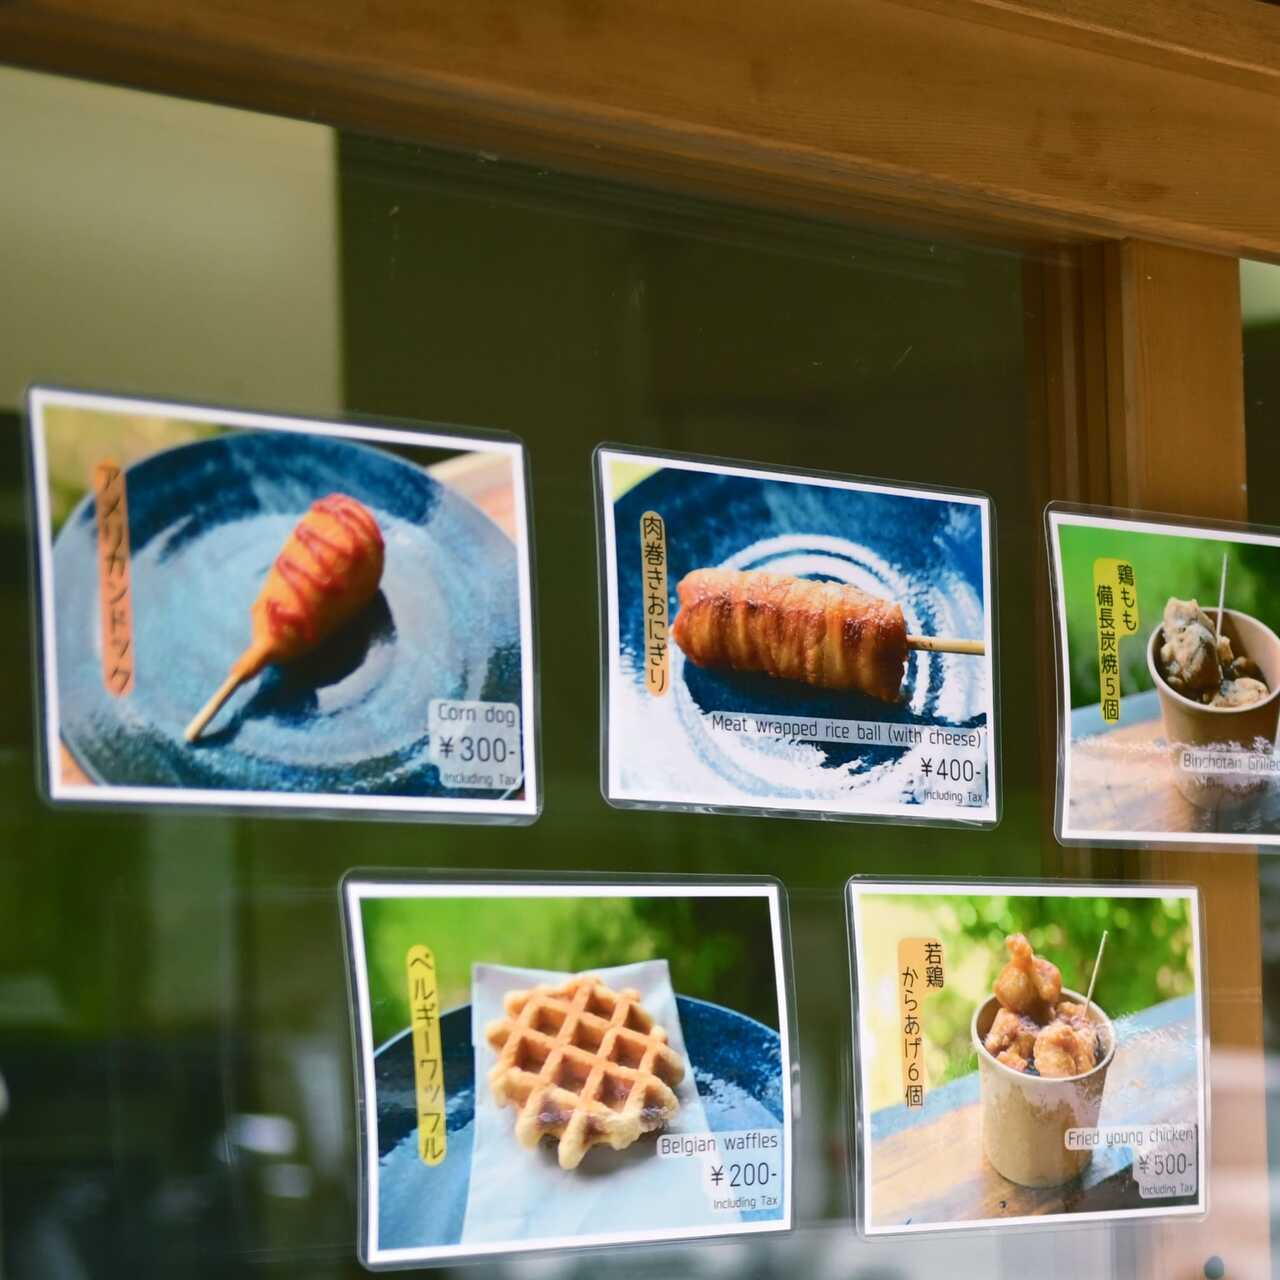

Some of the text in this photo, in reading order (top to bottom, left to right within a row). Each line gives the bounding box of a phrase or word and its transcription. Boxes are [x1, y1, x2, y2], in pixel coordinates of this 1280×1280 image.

[643, 515, 666, 693] 肉巻きおにぎり
[1116, 564, 1137, 632] 鶏もも
[1096, 584, 1120, 722] 備長炭焼5個
[437, 703, 516, 728] Corn dog
[711, 713, 982, 748] Meat wrapped rice ball (with cheese)
[1183, 752, 1242, 769] Binchotan
[444, 773, 494, 788] Including
[923, 789, 983, 803] Including Tax
[924, 942, 945, 989] 若鶏
[901, 965, 924, 1108] からあげ6個
[410, 952, 444, 1161] ベルギーワッフル
[660, 1132, 779, 1157] Belgian waffles
[1068, 1126, 1194, 1148] Fried young chicken
[1142, 1183, 1177, 1195] Including
[713, 1195, 778, 1210] Including Tax
